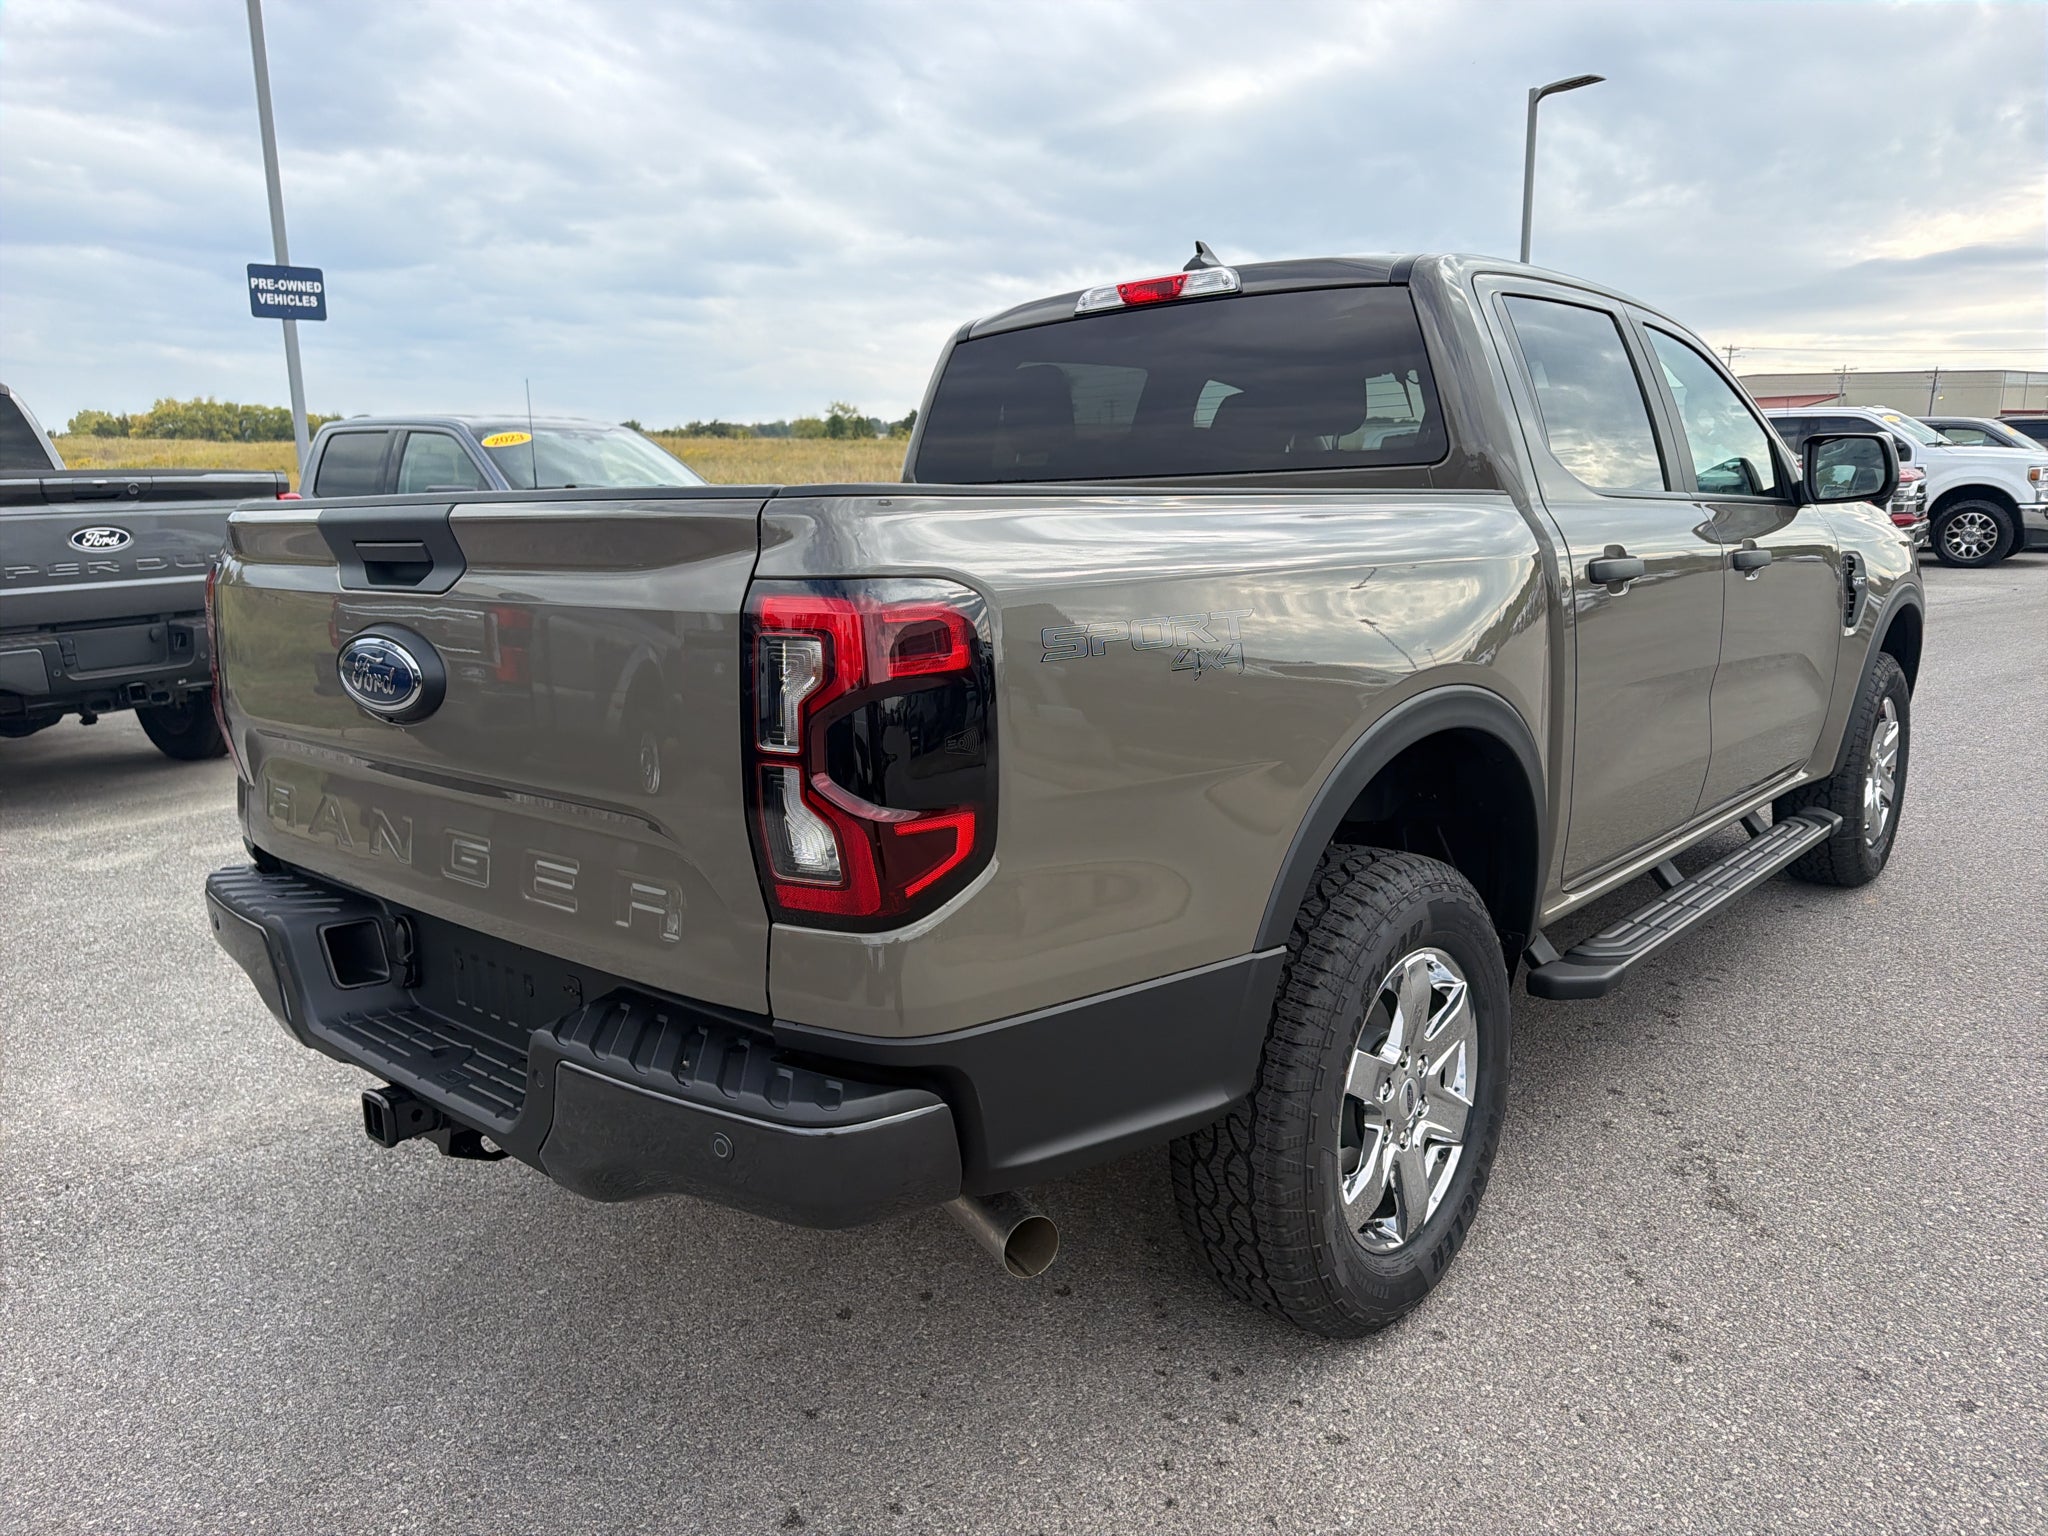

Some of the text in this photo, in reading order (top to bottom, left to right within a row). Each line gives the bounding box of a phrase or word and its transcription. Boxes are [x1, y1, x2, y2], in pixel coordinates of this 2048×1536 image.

[250, 277, 322, 293] PRE-OWNED
[257, 292, 318, 308] VEHICLES
[82, 530, 120, 547] Ford
[135, 552, 217, 571] DU
[1040, 607, 1256, 663] SPORT
[351, 652, 396, 696] Ford
[265, 775, 684, 943] RANGER
